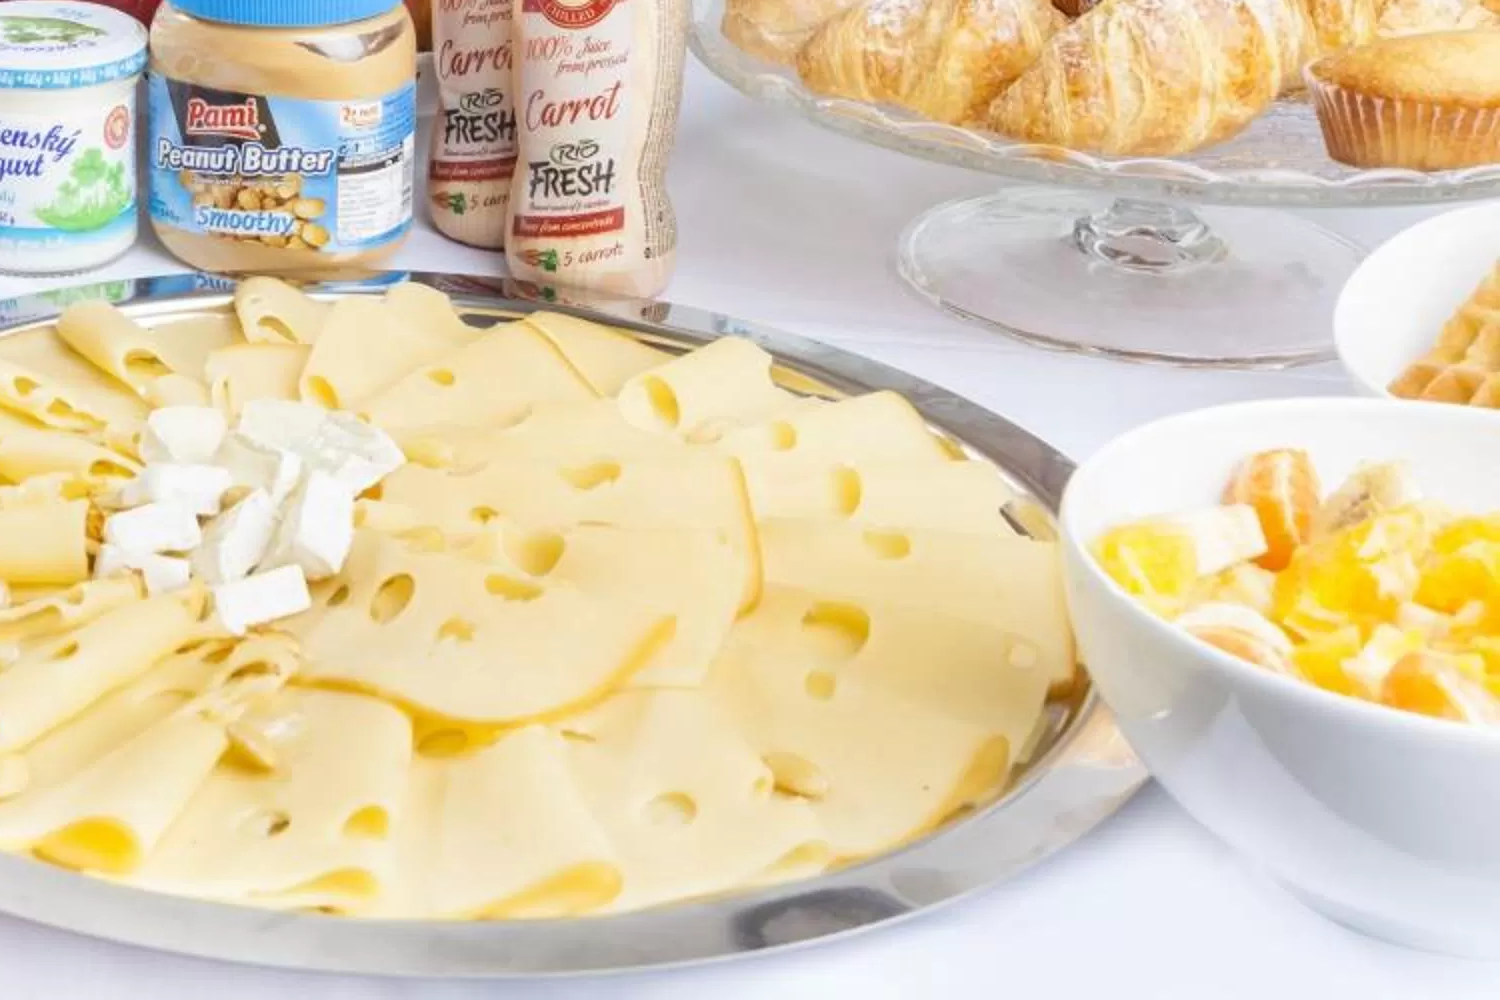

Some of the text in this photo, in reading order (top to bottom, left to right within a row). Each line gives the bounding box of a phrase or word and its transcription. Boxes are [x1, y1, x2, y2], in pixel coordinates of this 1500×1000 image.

[545, 2, 595, 22] CHILLED
[526, 35, 573, 62] 100%
[188, 97, 258, 130] Pami
[526, 80, 623, 133] Carrot
[444, 106, 517, 144] FRESH
[158, 137, 238, 174] Peanut
[242, 142, 335, 175] Butter
[528, 157, 615, 199] FRESH
[196, 207, 295, 235] Smoothy
[564, 251, 574, 267] 5
